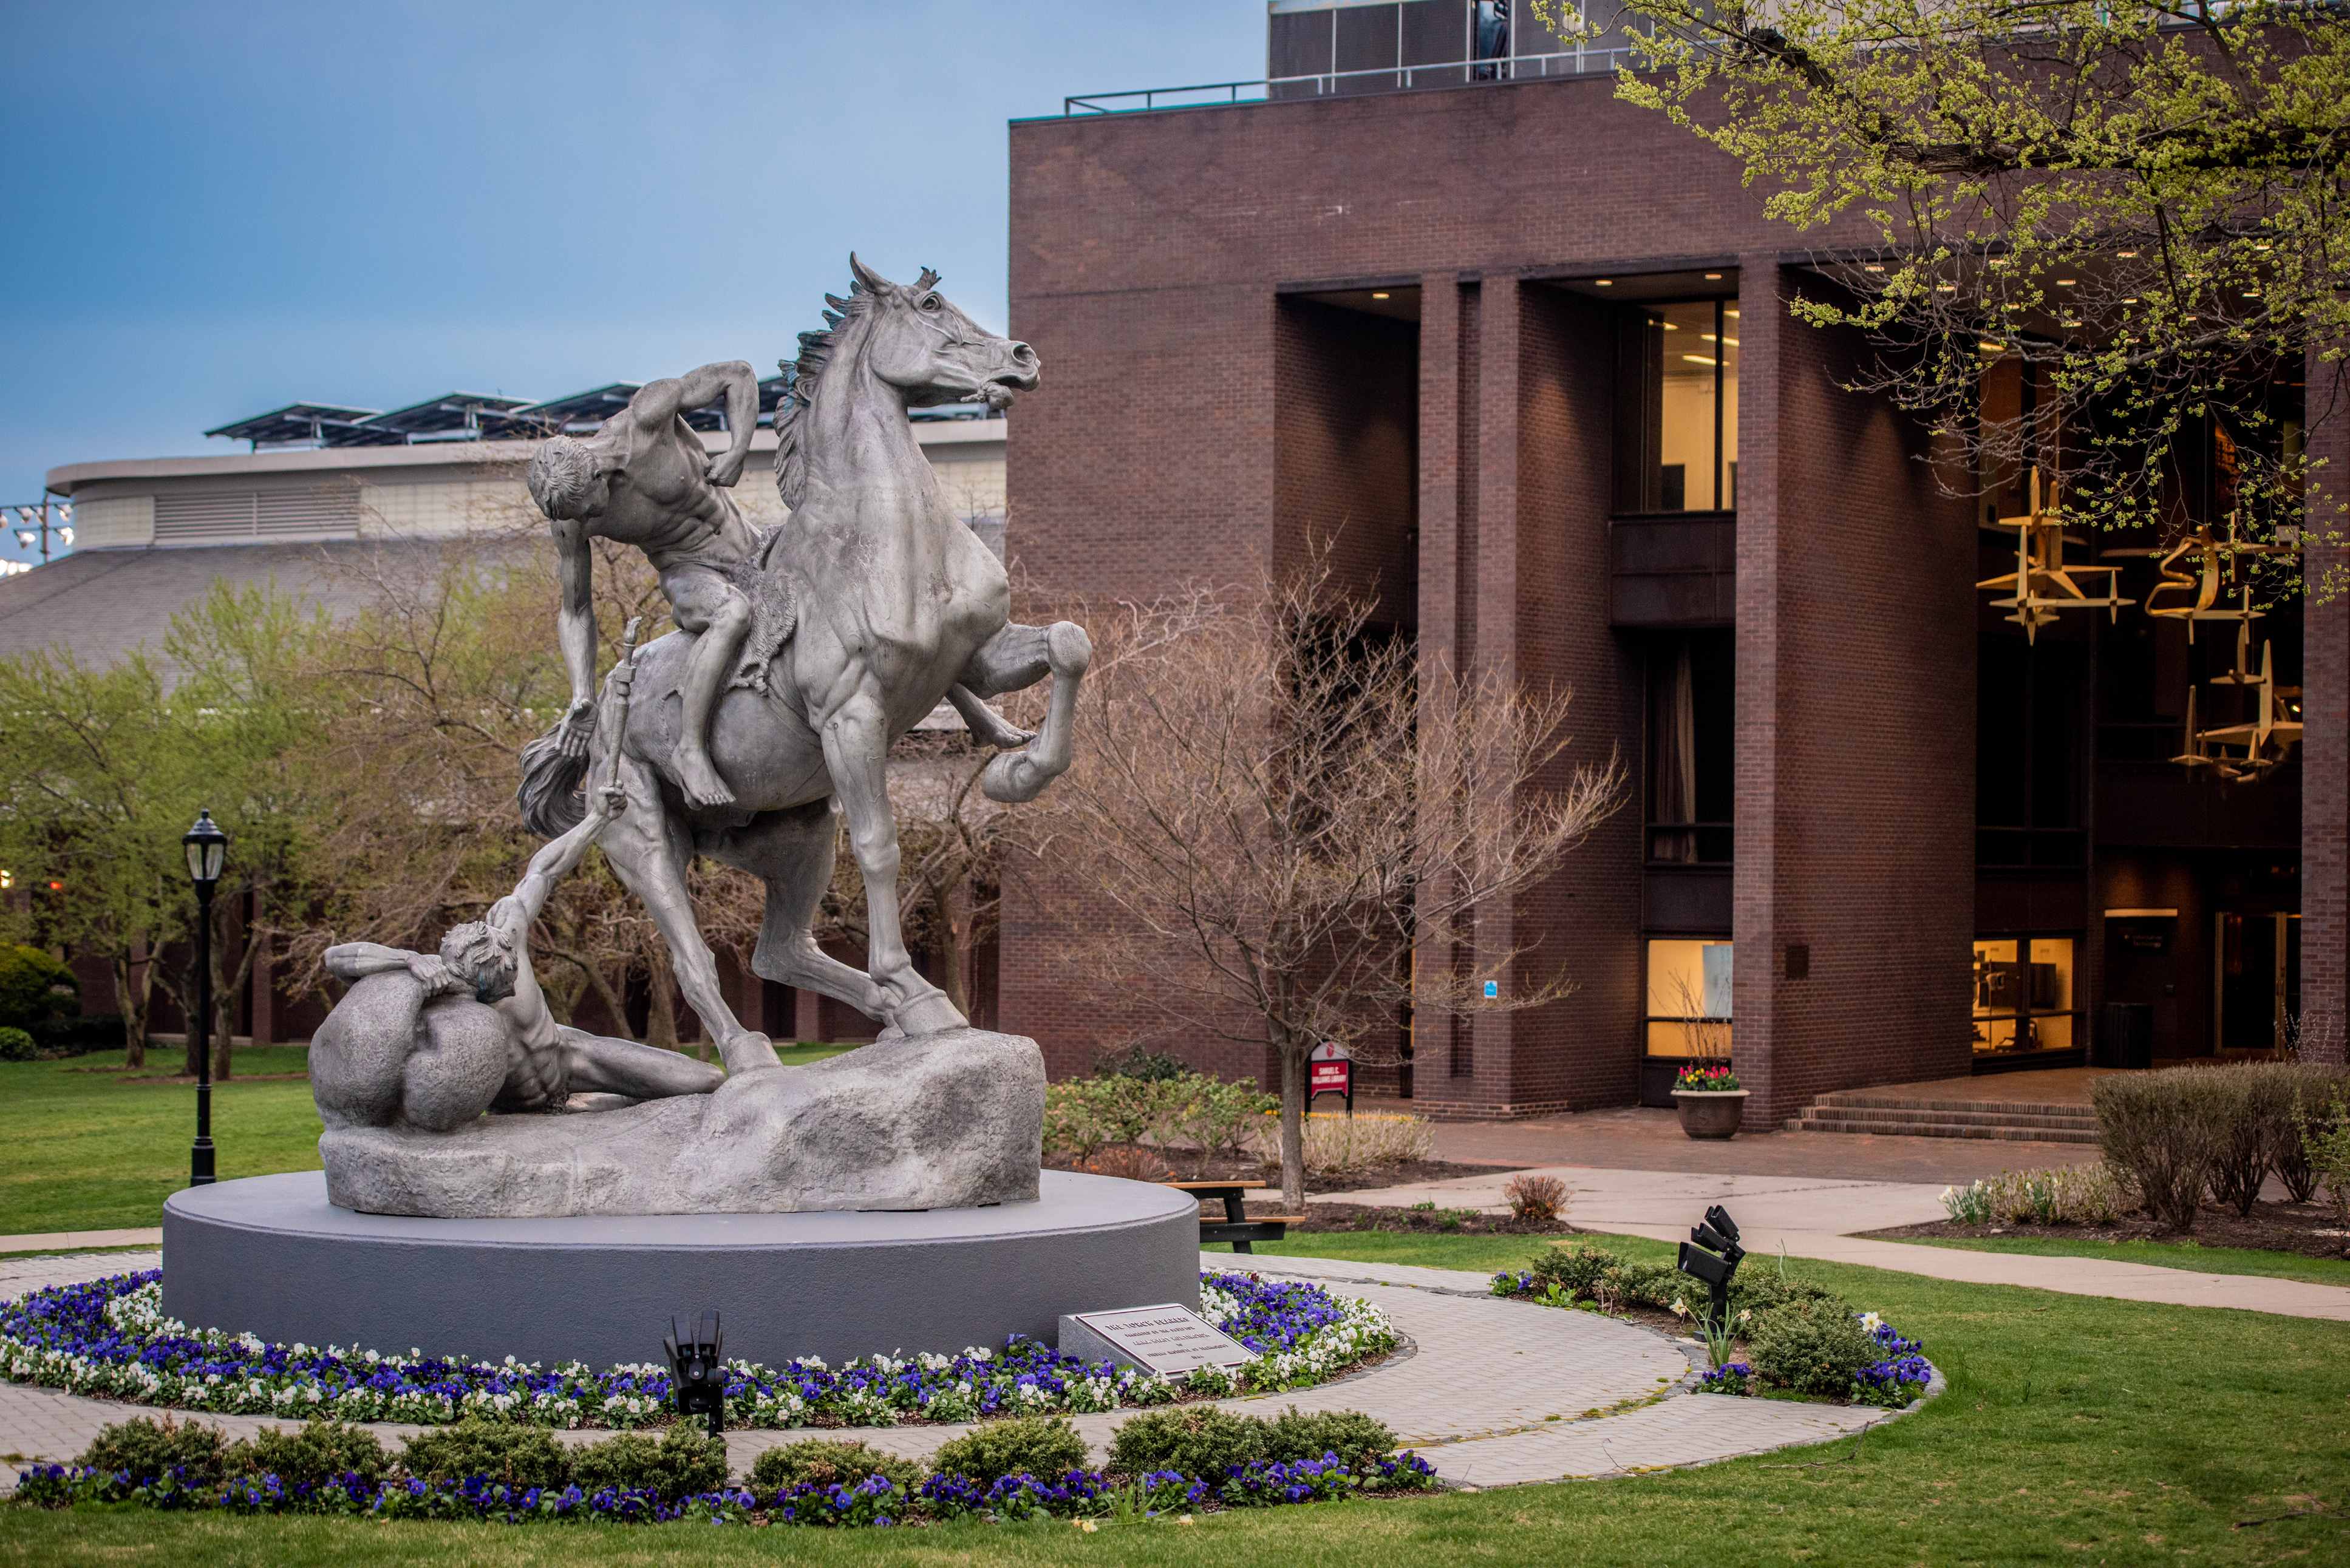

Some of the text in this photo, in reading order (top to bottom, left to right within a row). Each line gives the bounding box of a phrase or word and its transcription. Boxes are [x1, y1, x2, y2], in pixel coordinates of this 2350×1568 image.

[1312, 1074, 1347, 1084] WILLIAMS LIBRARY
[1123, 1320, 1154, 1329] TORCH
[1153, 1316, 1190, 1326] BEARERS
